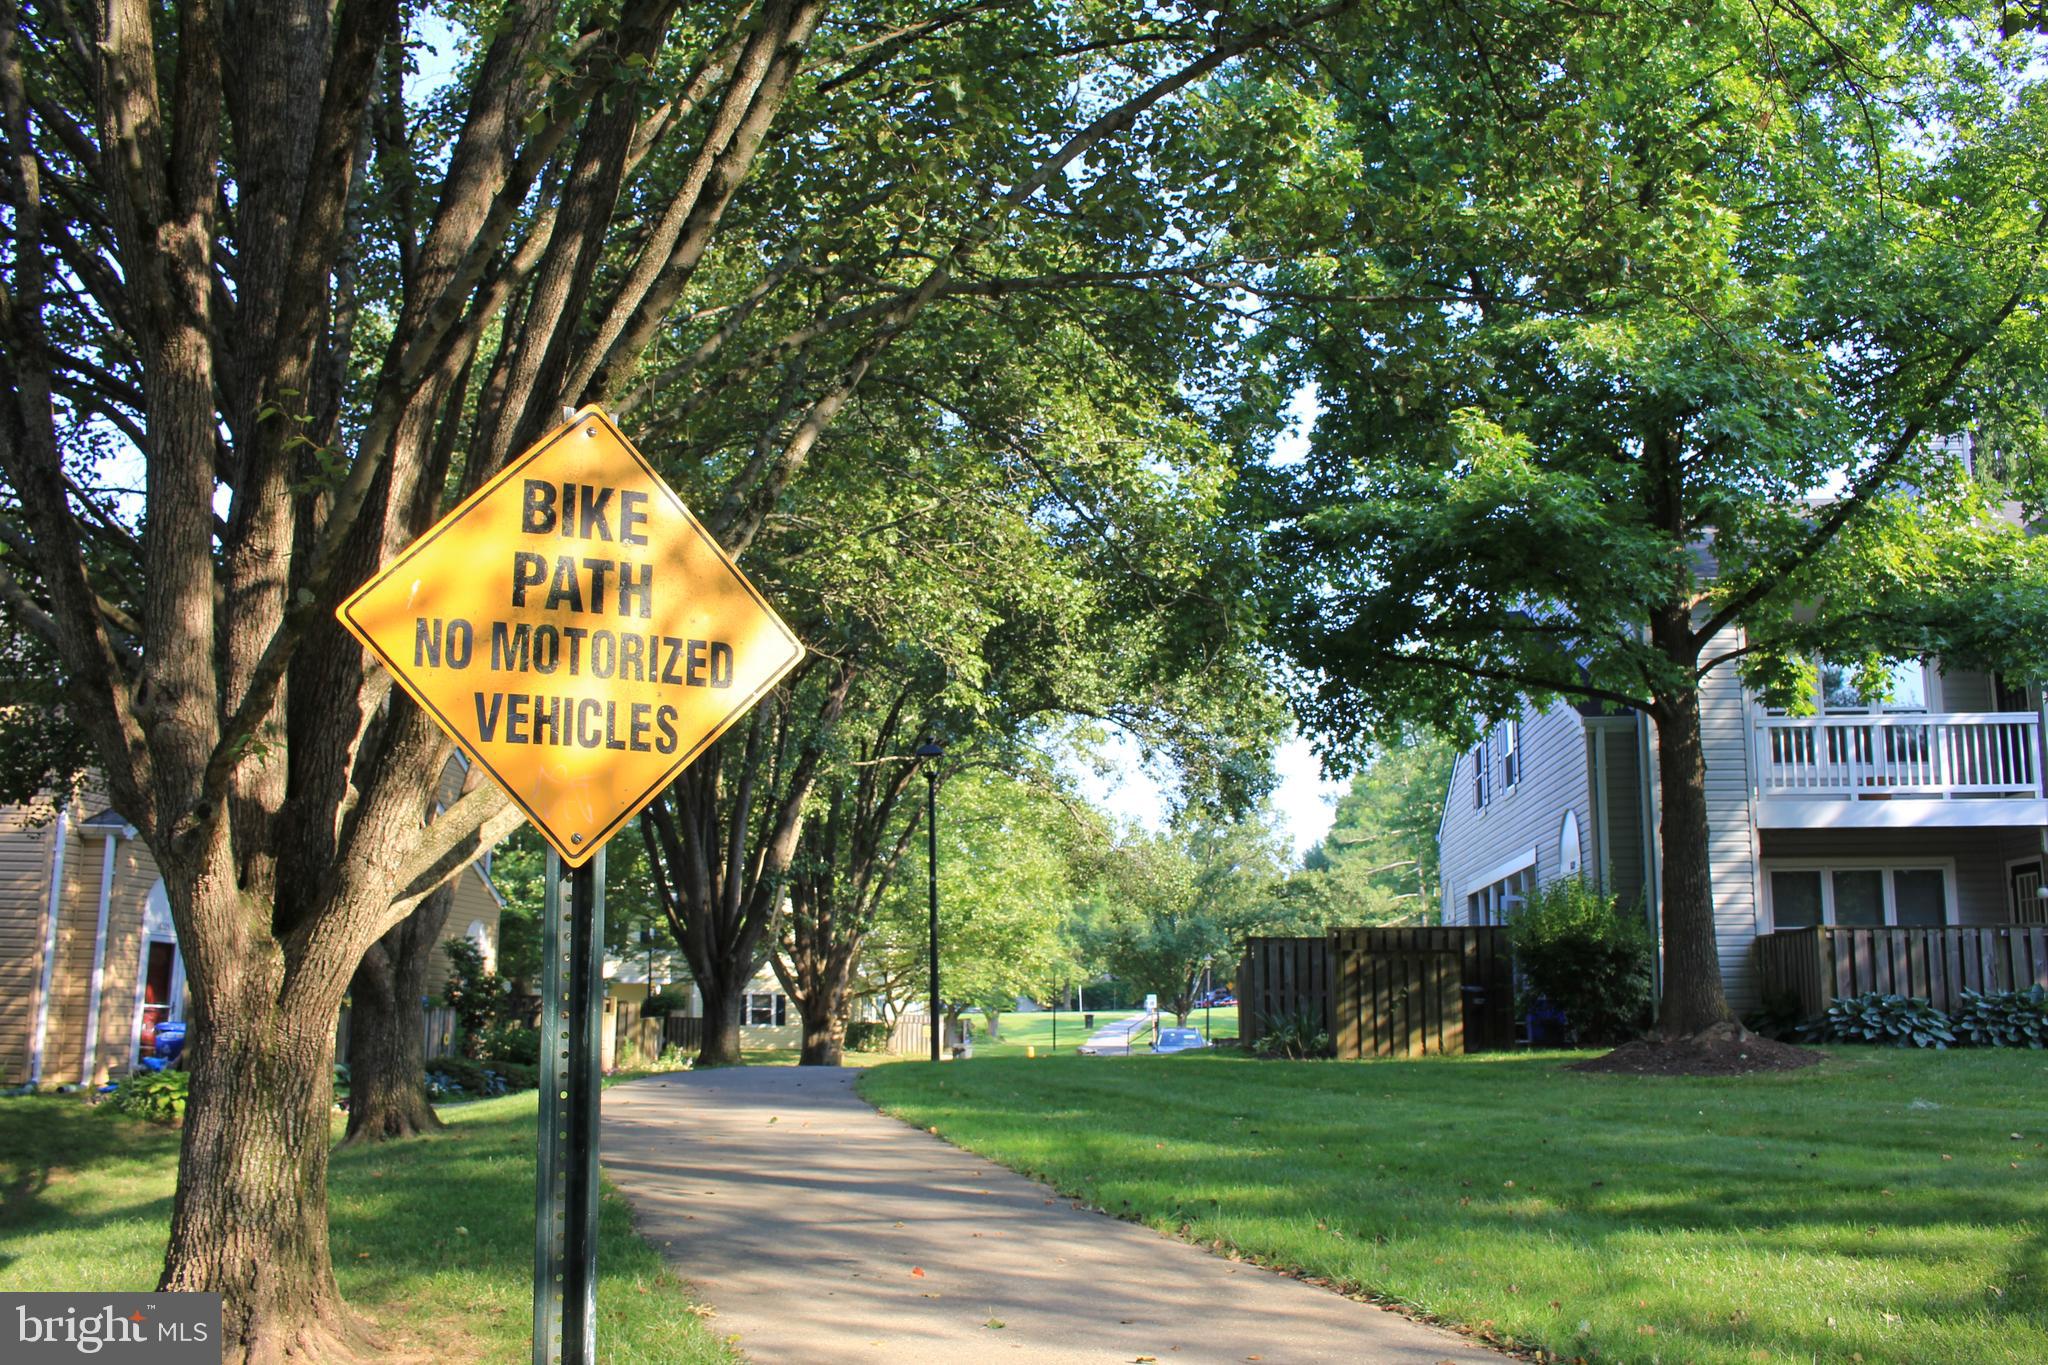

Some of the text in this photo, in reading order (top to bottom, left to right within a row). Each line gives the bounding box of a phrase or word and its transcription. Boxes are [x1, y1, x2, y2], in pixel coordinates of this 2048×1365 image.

[521, 479, 649, 546] BIKE
[511, 551, 653, 619] PATH
[413, 617, 734, 689] NO MOTORIZED
[474, 692, 679, 755] VEHICLES
